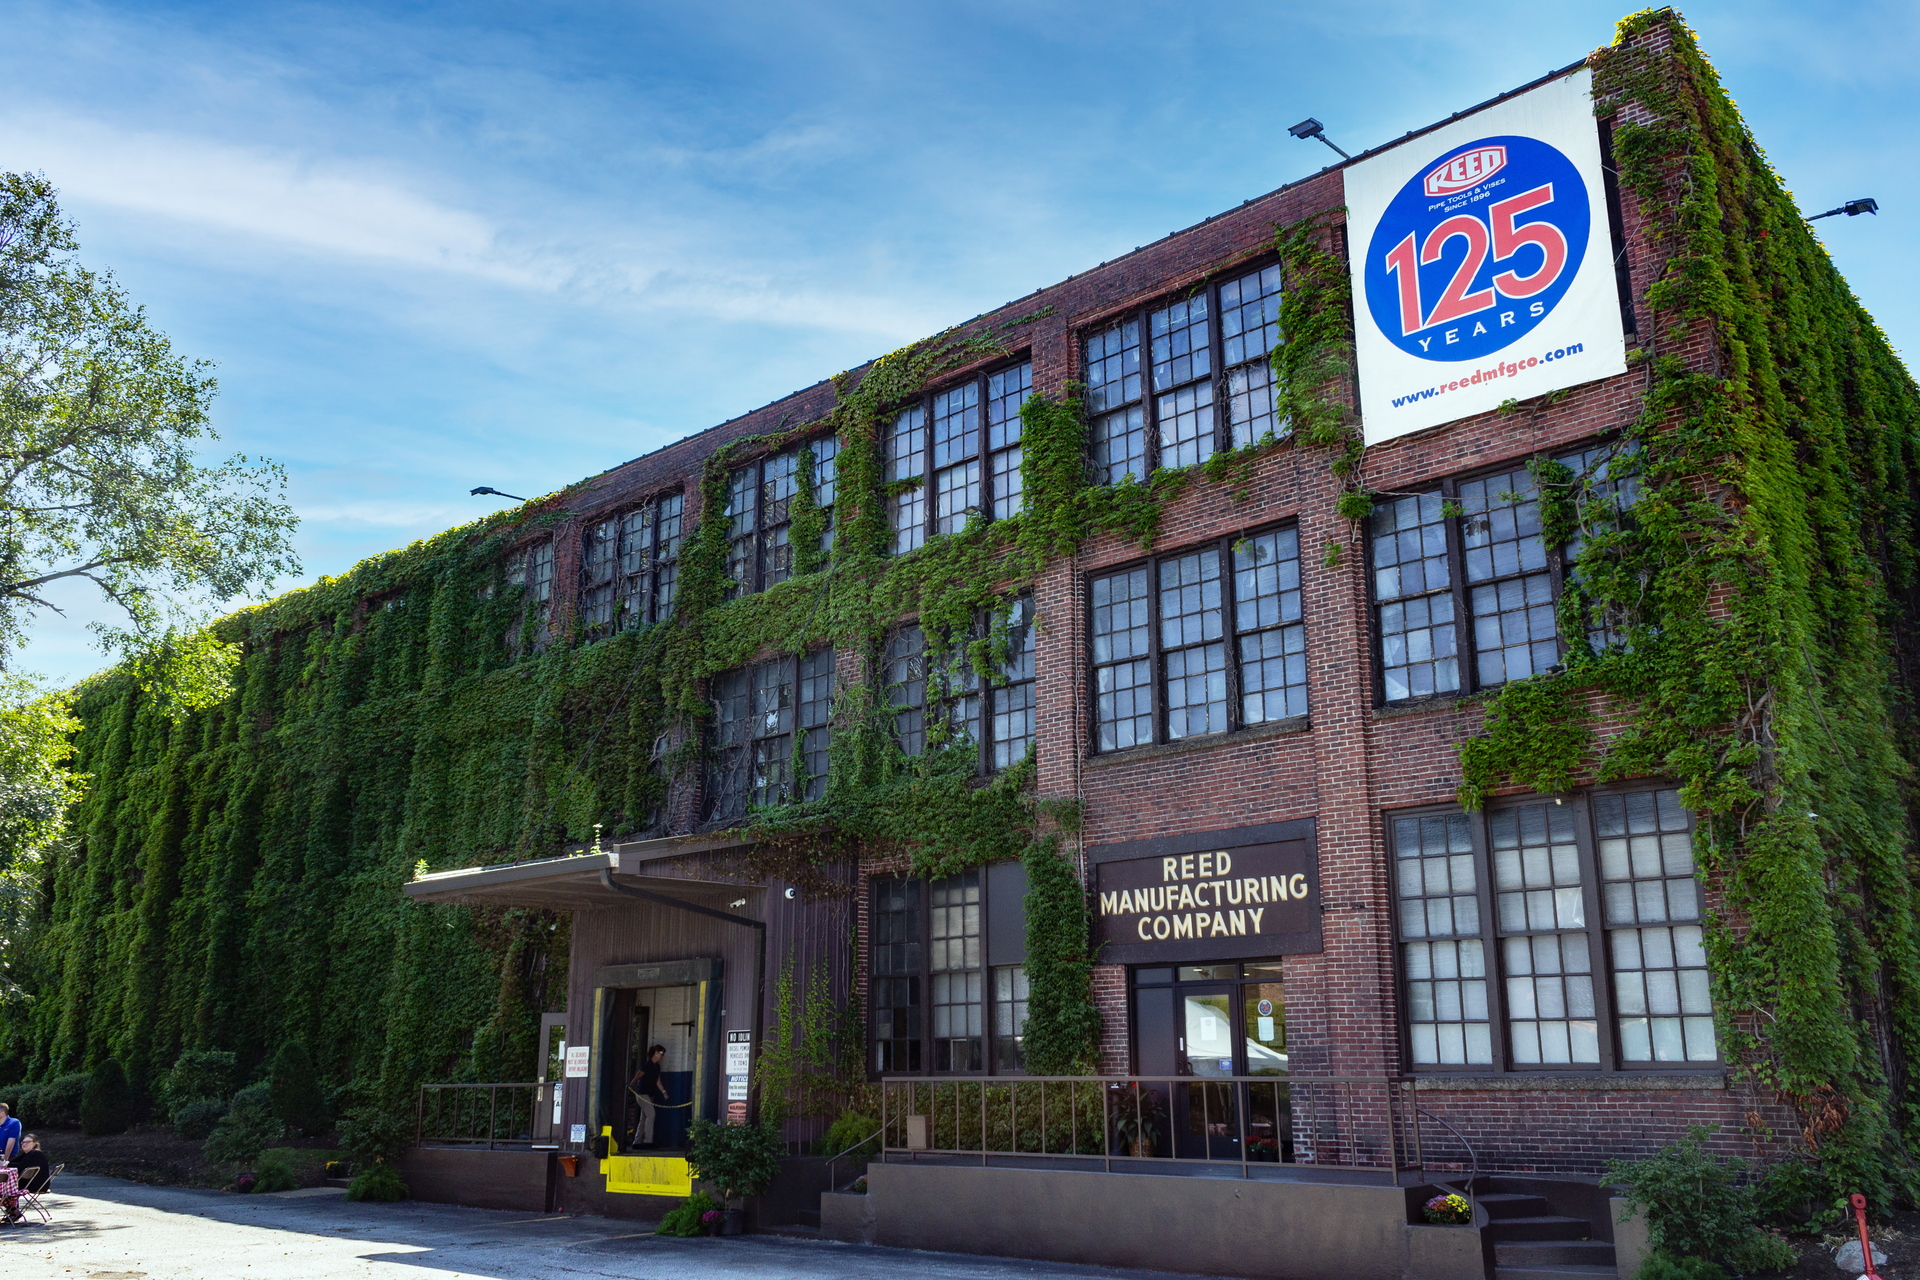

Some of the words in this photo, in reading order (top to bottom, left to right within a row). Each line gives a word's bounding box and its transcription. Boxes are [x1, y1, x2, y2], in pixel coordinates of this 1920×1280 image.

[1429, 150, 1502, 193] REED
[1428, 201, 1446, 212] PIPE
[1447, 190, 1473, 204] TOOLS
[1474, 187, 1482, 195] &
[1482, 177, 1507, 191] VISES
[1444, 200, 1468, 213] SINCE
[1470, 190, 1491, 203] 1896
[1385, 182, 1568, 337] 125
[1418, 301, 1545, 353] YEARS
[1391, 342, 1584, 408] www.reedmfgco.com
[1163, 851, 1232, 882] REED
[1099, 873, 1309, 917] MANUFACTURING
[1137, 907, 1265, 941] COMPANY
[738, 1032, 751, 1042] IDLIN
